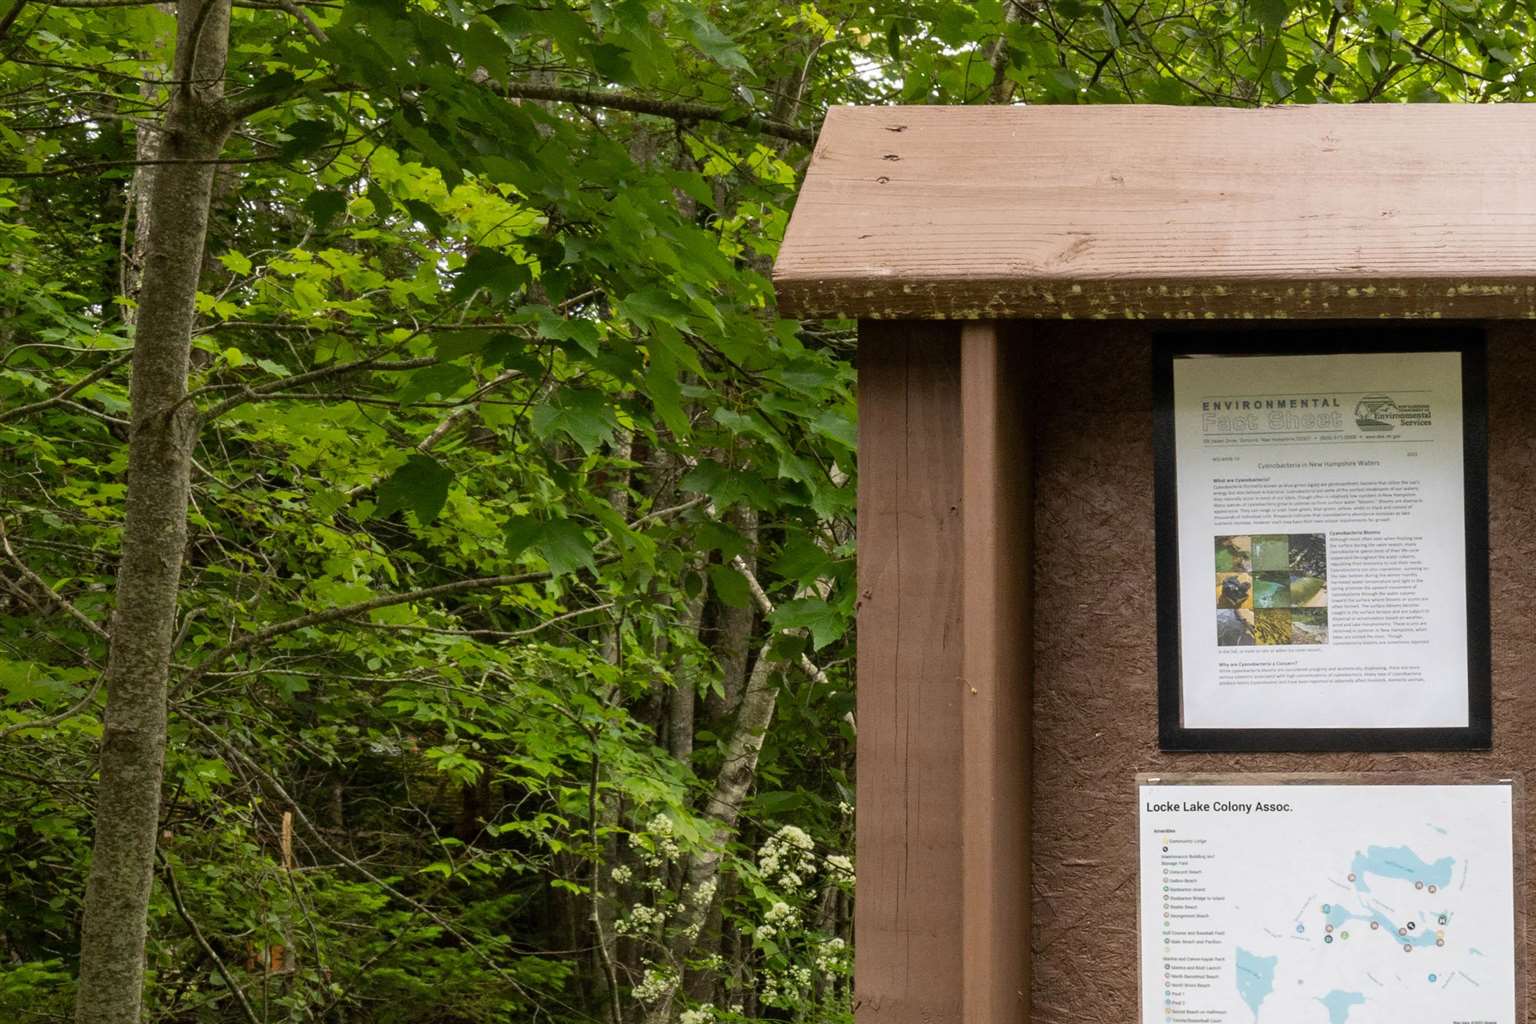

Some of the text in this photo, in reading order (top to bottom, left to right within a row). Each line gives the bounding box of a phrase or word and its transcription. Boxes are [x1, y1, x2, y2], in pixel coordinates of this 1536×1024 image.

[1202, 398, 1341, 411] ENVIRONMENTAL
[1201, 411, 1344, 432] Fact Sheet
[1374, 411, 1432, 420] Environmental
[1400, 419, 1432, 427] Services
[1147, 800, 1293, 814] Locke Lake Colony Assoc.
